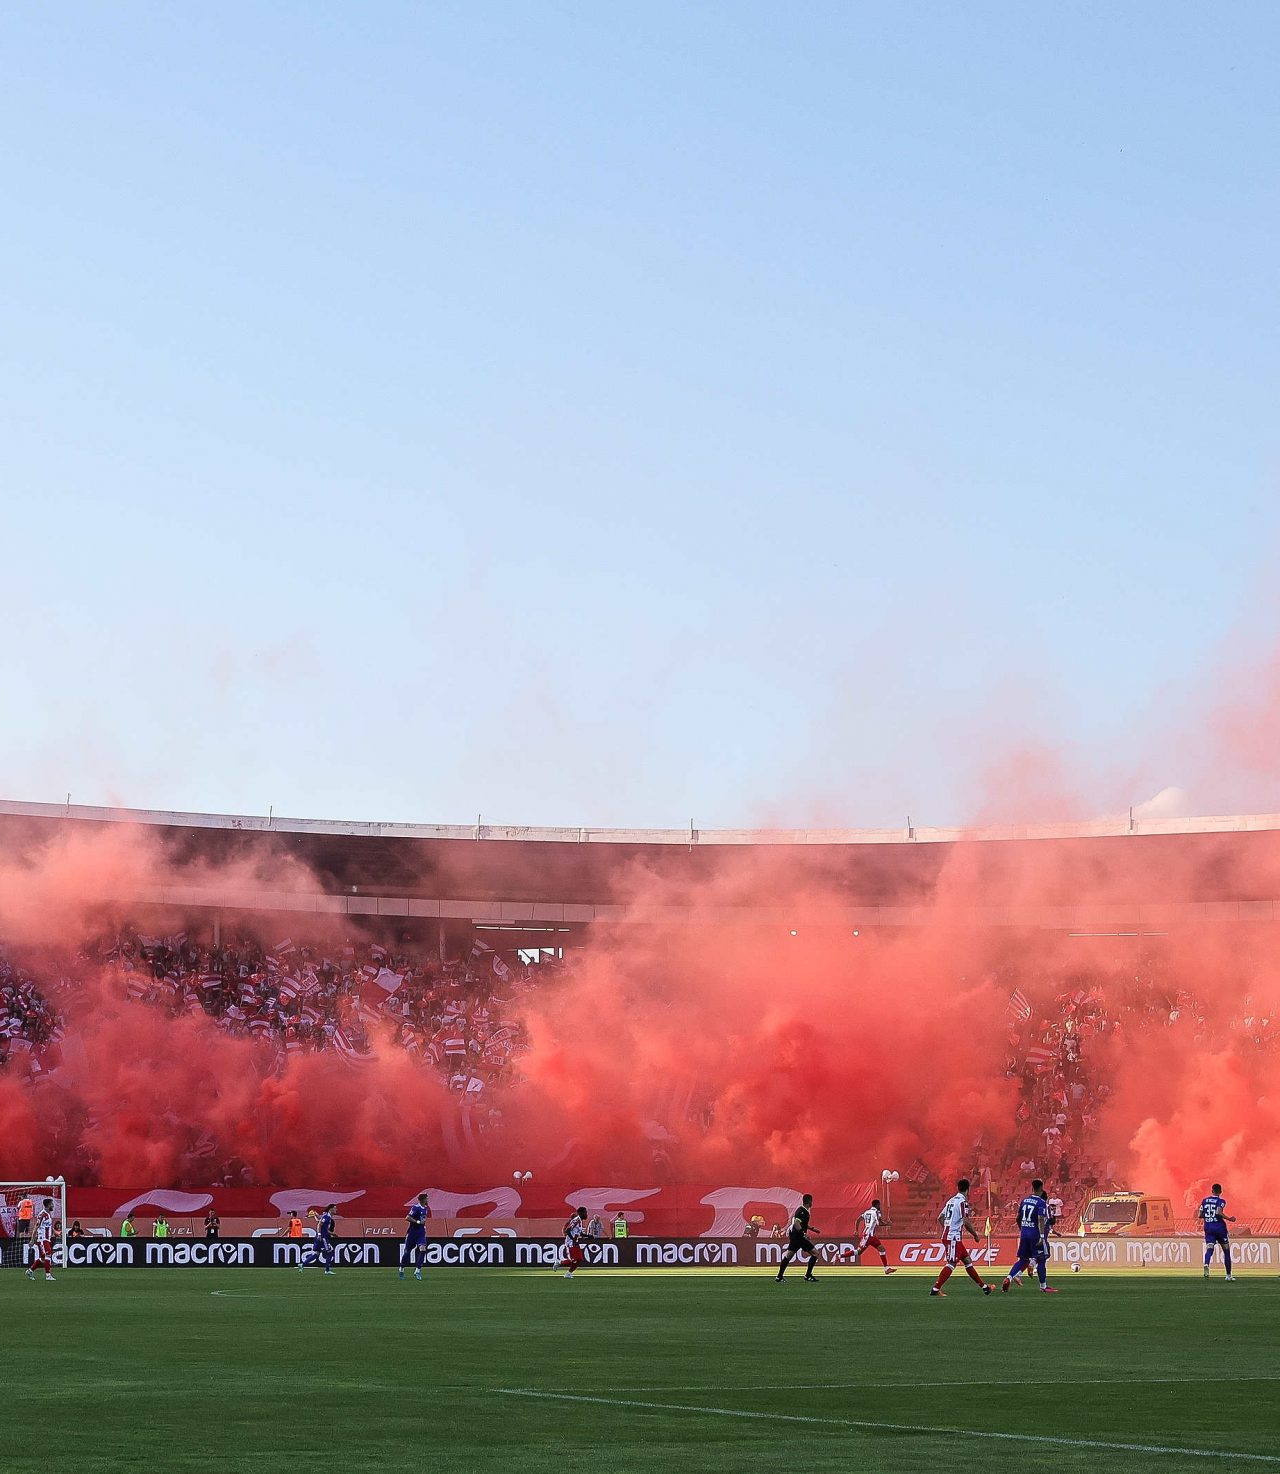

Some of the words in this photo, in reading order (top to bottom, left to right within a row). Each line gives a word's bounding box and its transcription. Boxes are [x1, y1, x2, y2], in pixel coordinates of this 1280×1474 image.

[1021, 1204, 1035, 1222] 17
[1204, 1204, 1216, 1218] 35
[168, 1227, 193, 1235] UEL
[365, 1227, 397, 1235] FUEL
[145, 1243, 255, 1264] macron
[636, 1243, 738, 1264] macron
[1126, 1241, 1191, 1263] macron
